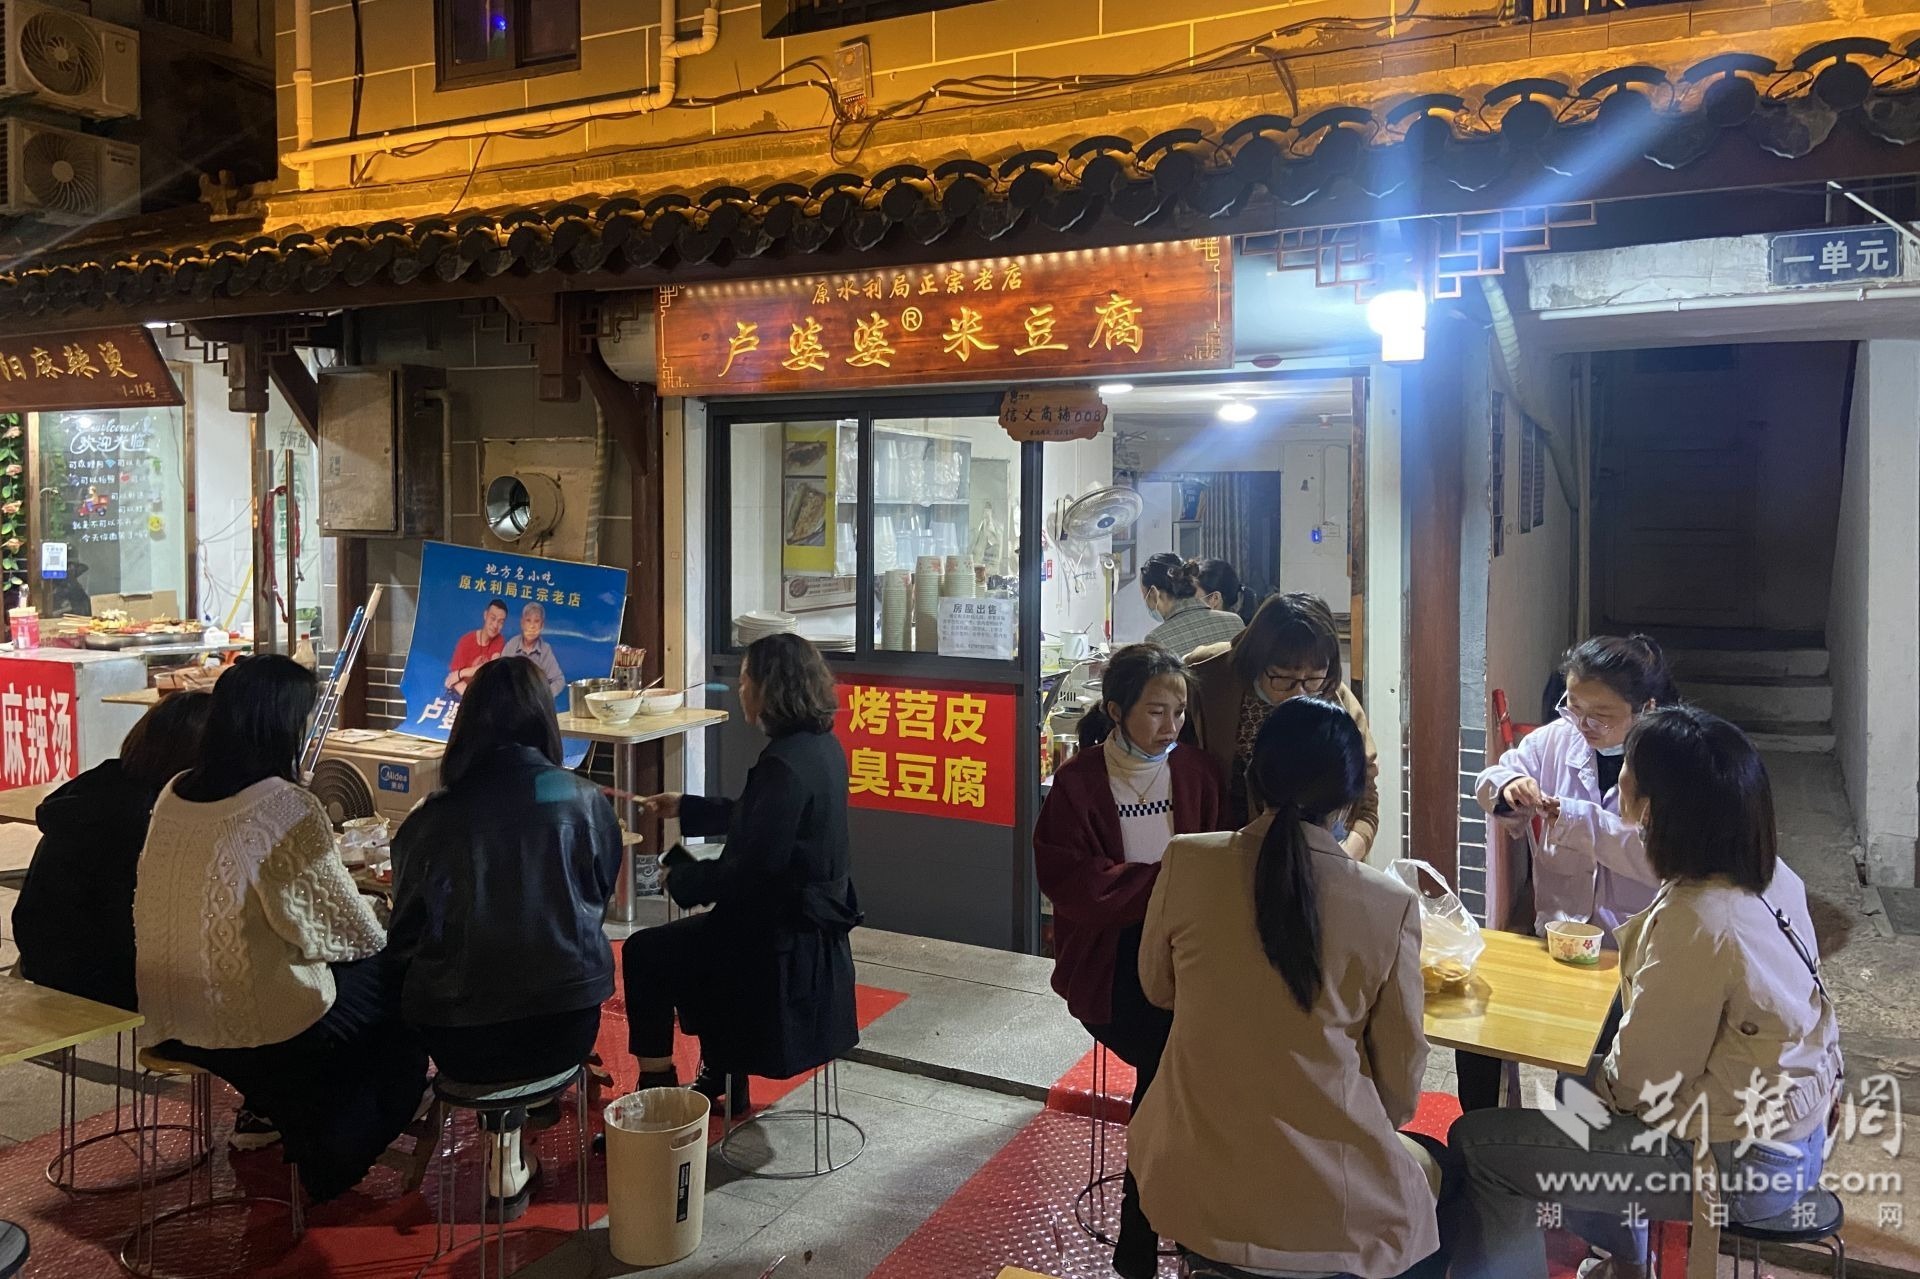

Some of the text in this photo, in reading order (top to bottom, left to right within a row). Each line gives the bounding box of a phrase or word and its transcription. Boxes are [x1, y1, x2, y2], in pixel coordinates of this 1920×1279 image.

[1783, 240, 1889, 275] 一单元
[812, 263, 1024, 306] 原水利局正宗老店
[71, 432, 149, 454] 欢迎光临
[484, 562, 556, 586] 地方名小吃
[458, 575, 582, 608] 原水利局正宗老店
[953, 603, 997, 615] 房屋出售
[848, 685, 988, 745] 烤苕皮
[2, 682, 73, 786] 麻辣烫
[383, 767, 408, 783] Midea
[848, 747, 988, 808] 臭豆腐
